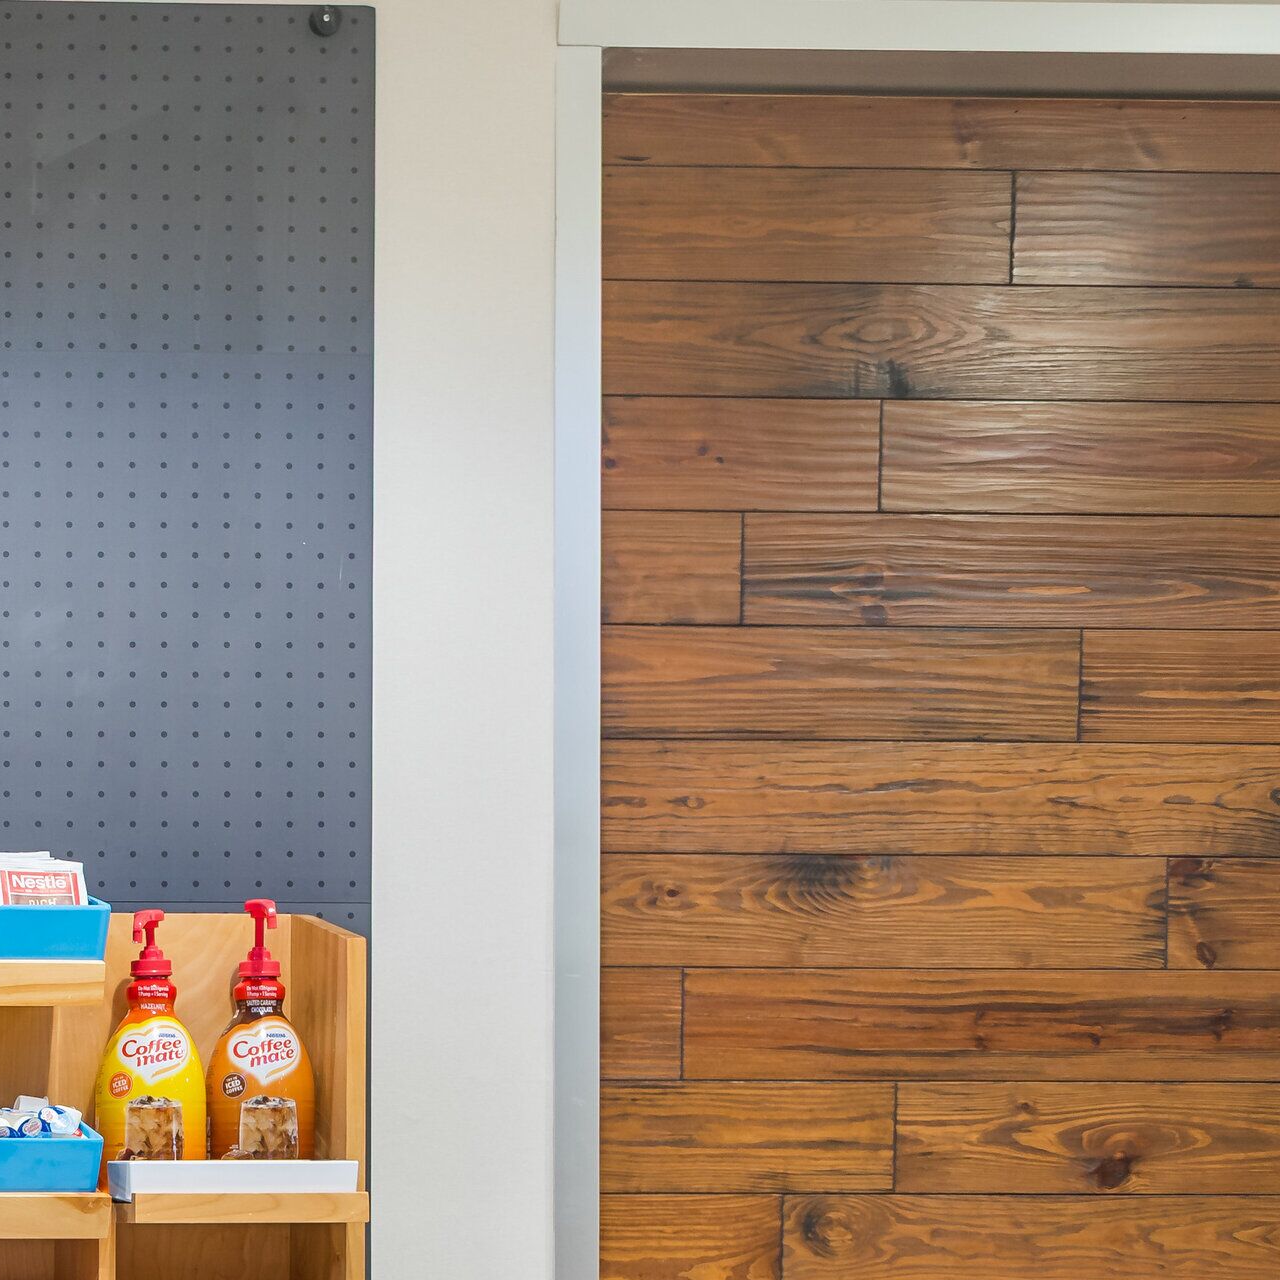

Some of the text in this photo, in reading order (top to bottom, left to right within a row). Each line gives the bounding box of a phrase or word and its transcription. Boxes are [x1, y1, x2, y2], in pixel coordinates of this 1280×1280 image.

[121, 1039, 182, 1058] Coffee
[233, 1039, 292, 1058] Coffee
[137, 1049, 184, 1067] mate
[250, 1048, 295, 1068] mate
[112, 1079, 127, 1088] ICED
[225, 1079, 241, 1089] ICED
[226, 1085, 243, 1095] COFFEE
